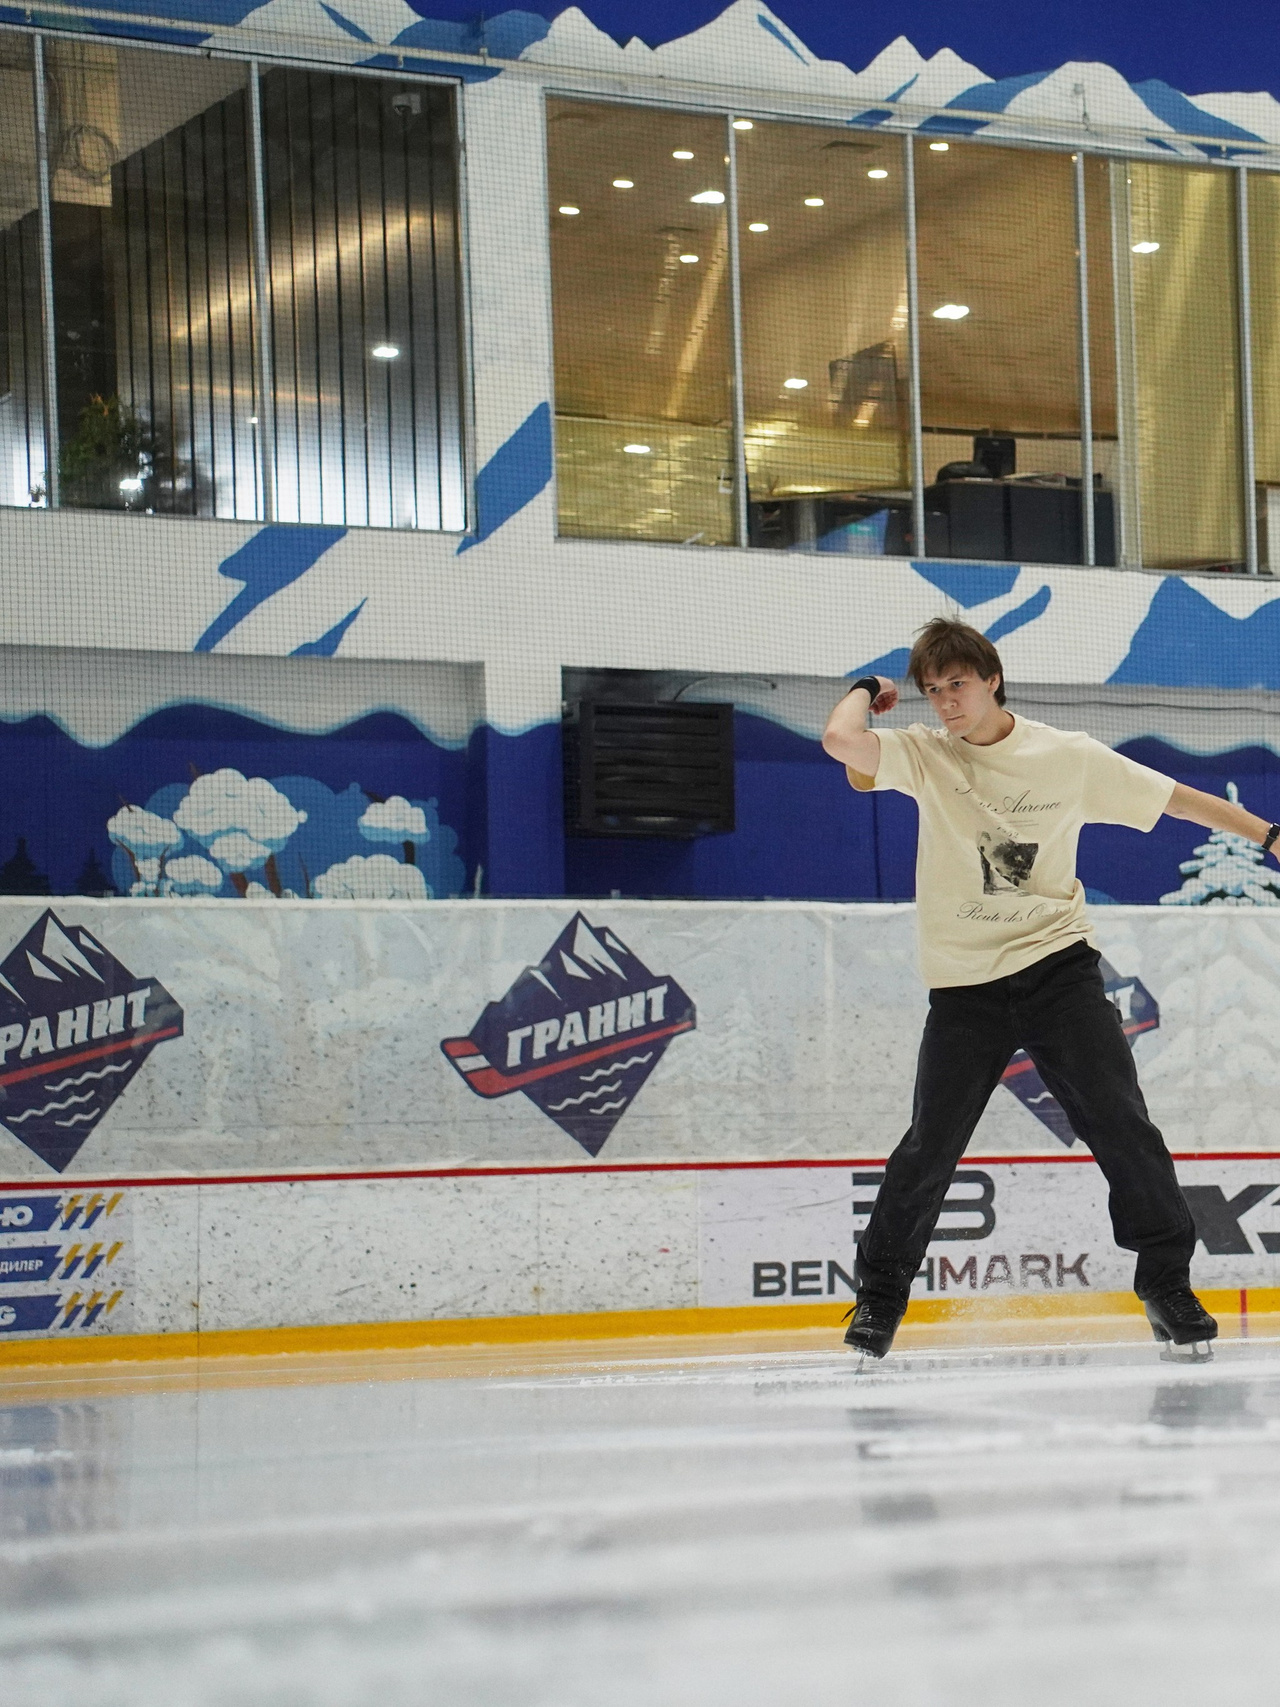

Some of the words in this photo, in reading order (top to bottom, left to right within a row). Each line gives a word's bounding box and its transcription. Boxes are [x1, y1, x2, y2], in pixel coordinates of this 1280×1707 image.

[0, 986, 151, 1066] РАНИТ
[506, 983, 668, 1068] ГРАНИТ
[753, 1252, 1090, 1298] BENHMARK
